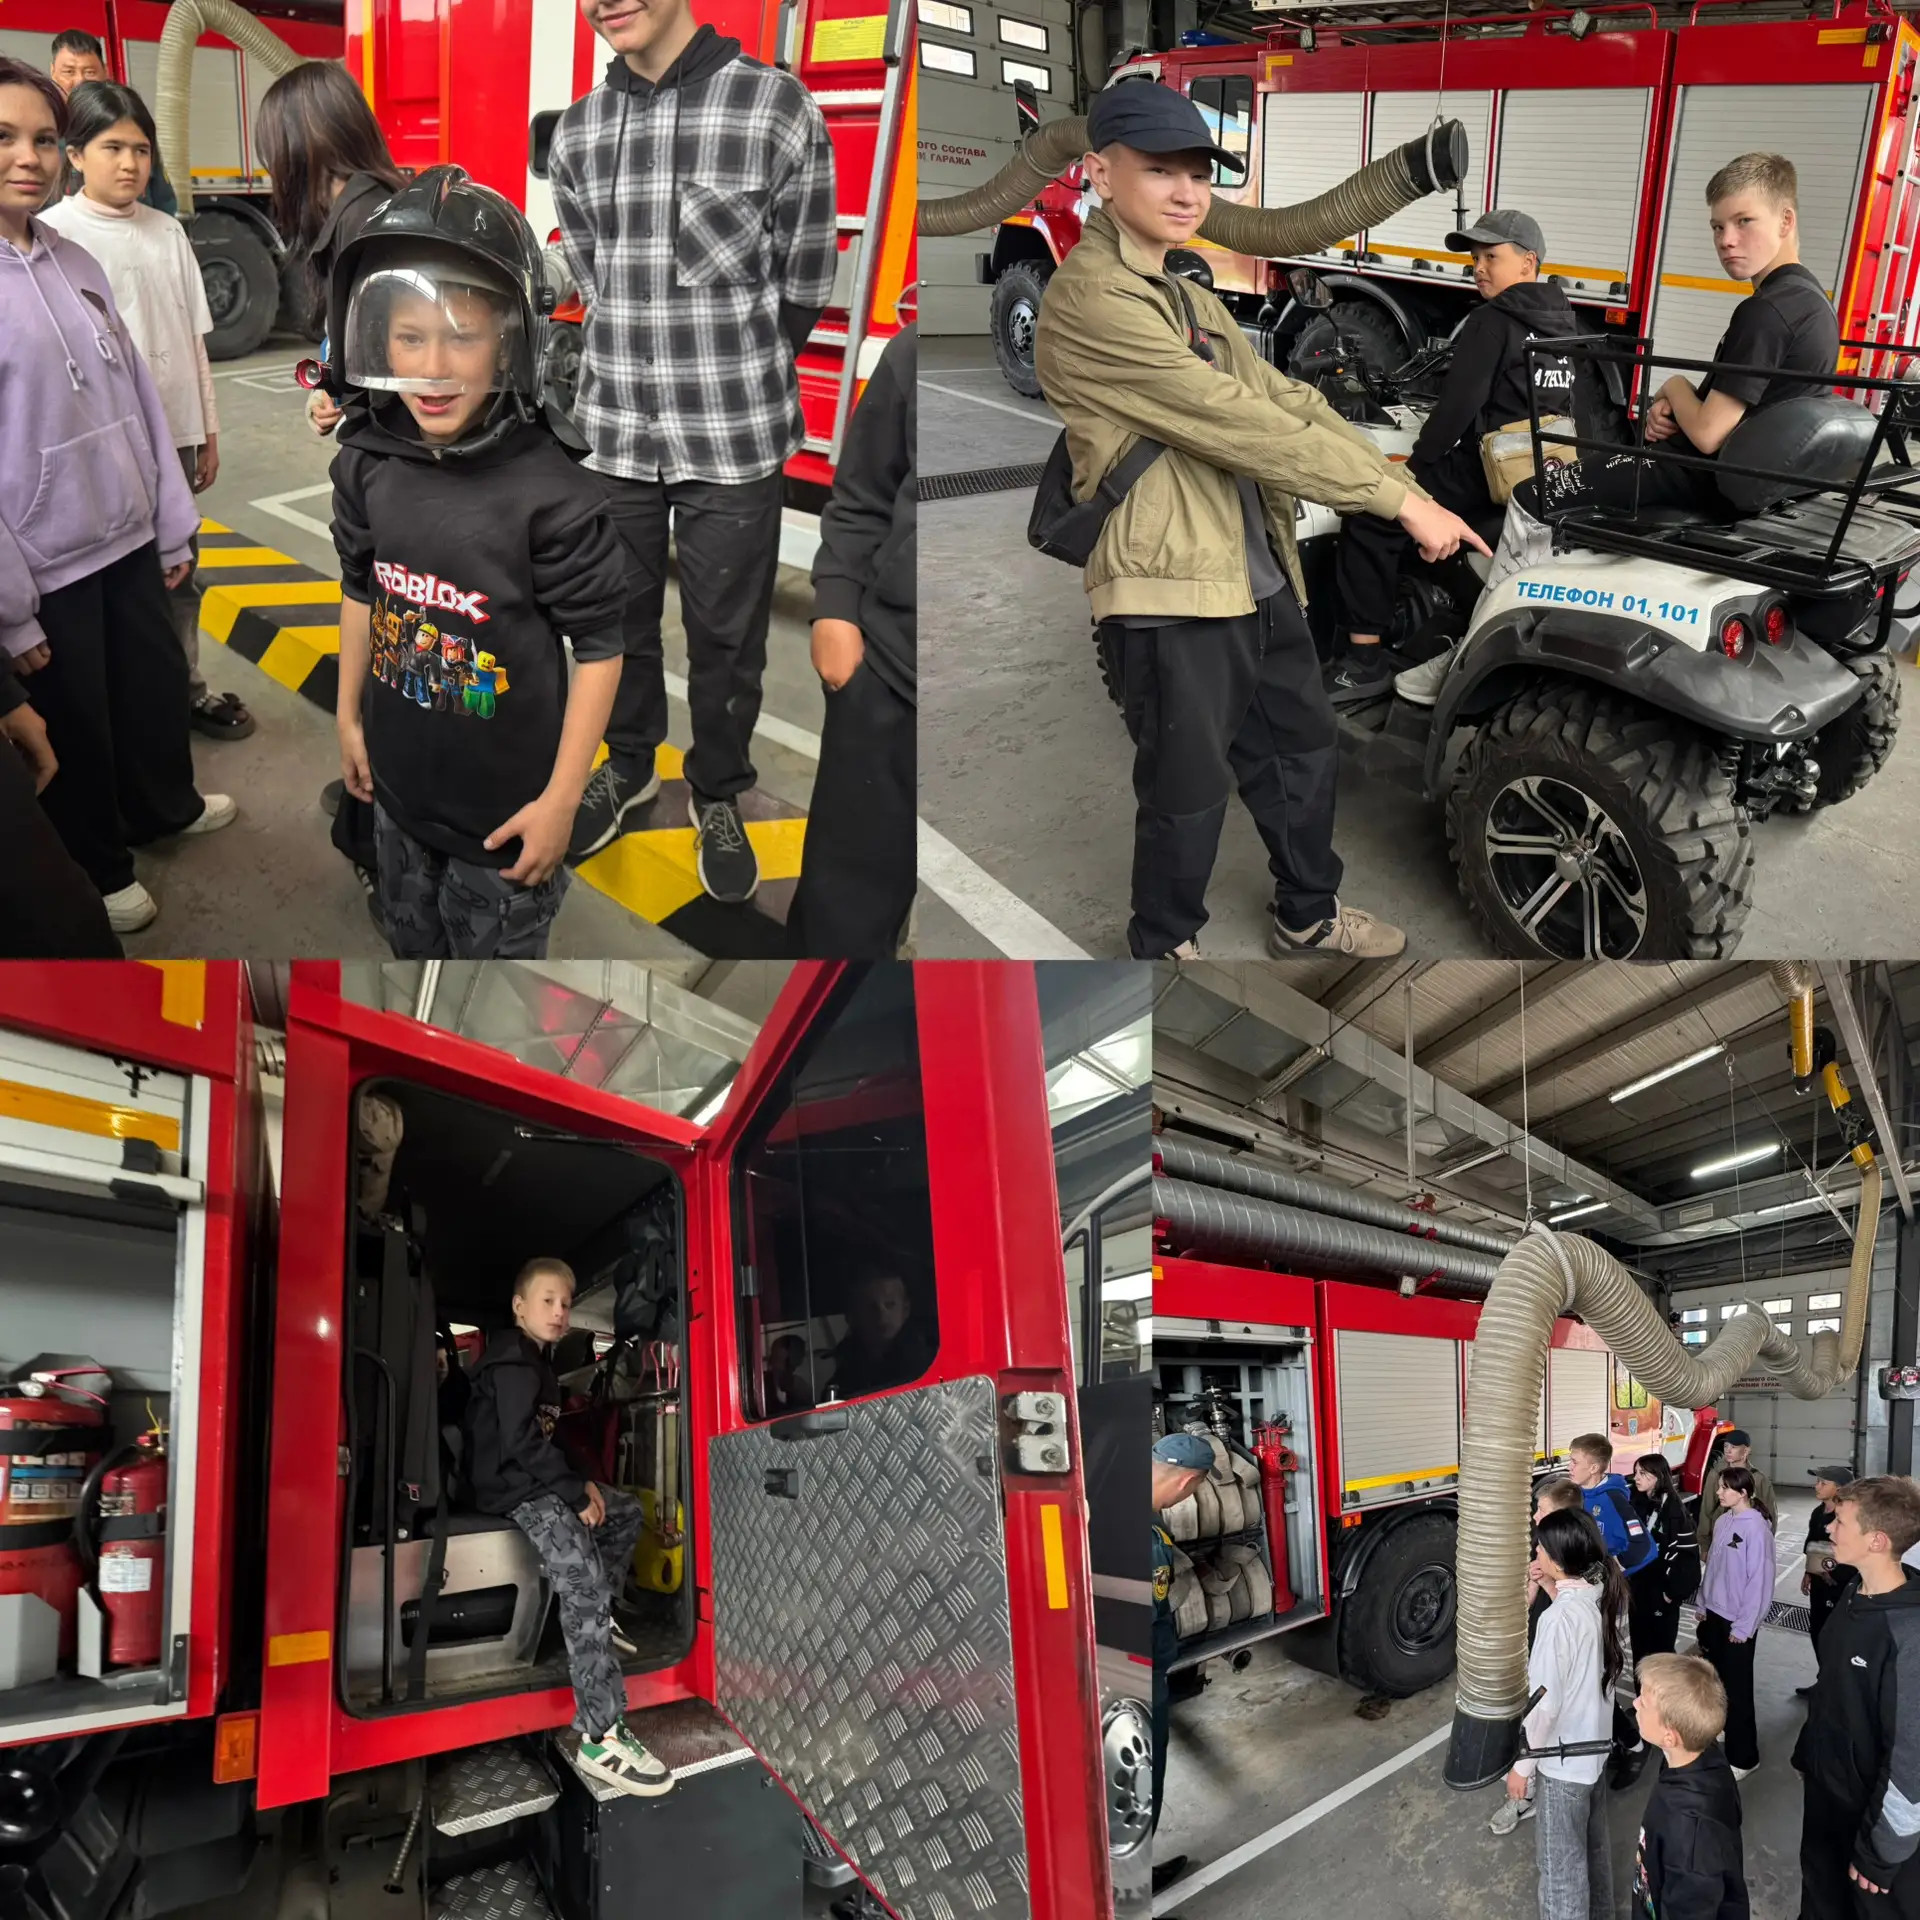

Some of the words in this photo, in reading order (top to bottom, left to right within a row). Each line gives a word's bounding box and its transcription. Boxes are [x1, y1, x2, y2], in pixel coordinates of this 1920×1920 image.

[941, 144, 987, 158] СОСТАВА
[931, 153, 971, 166] ГАРАЖА
[1518, 582, 1614, 608] ТЕЛЕФОН
[1622, 595, 1652, 618] 01,
[1658, 602, 1699, 624] 101
